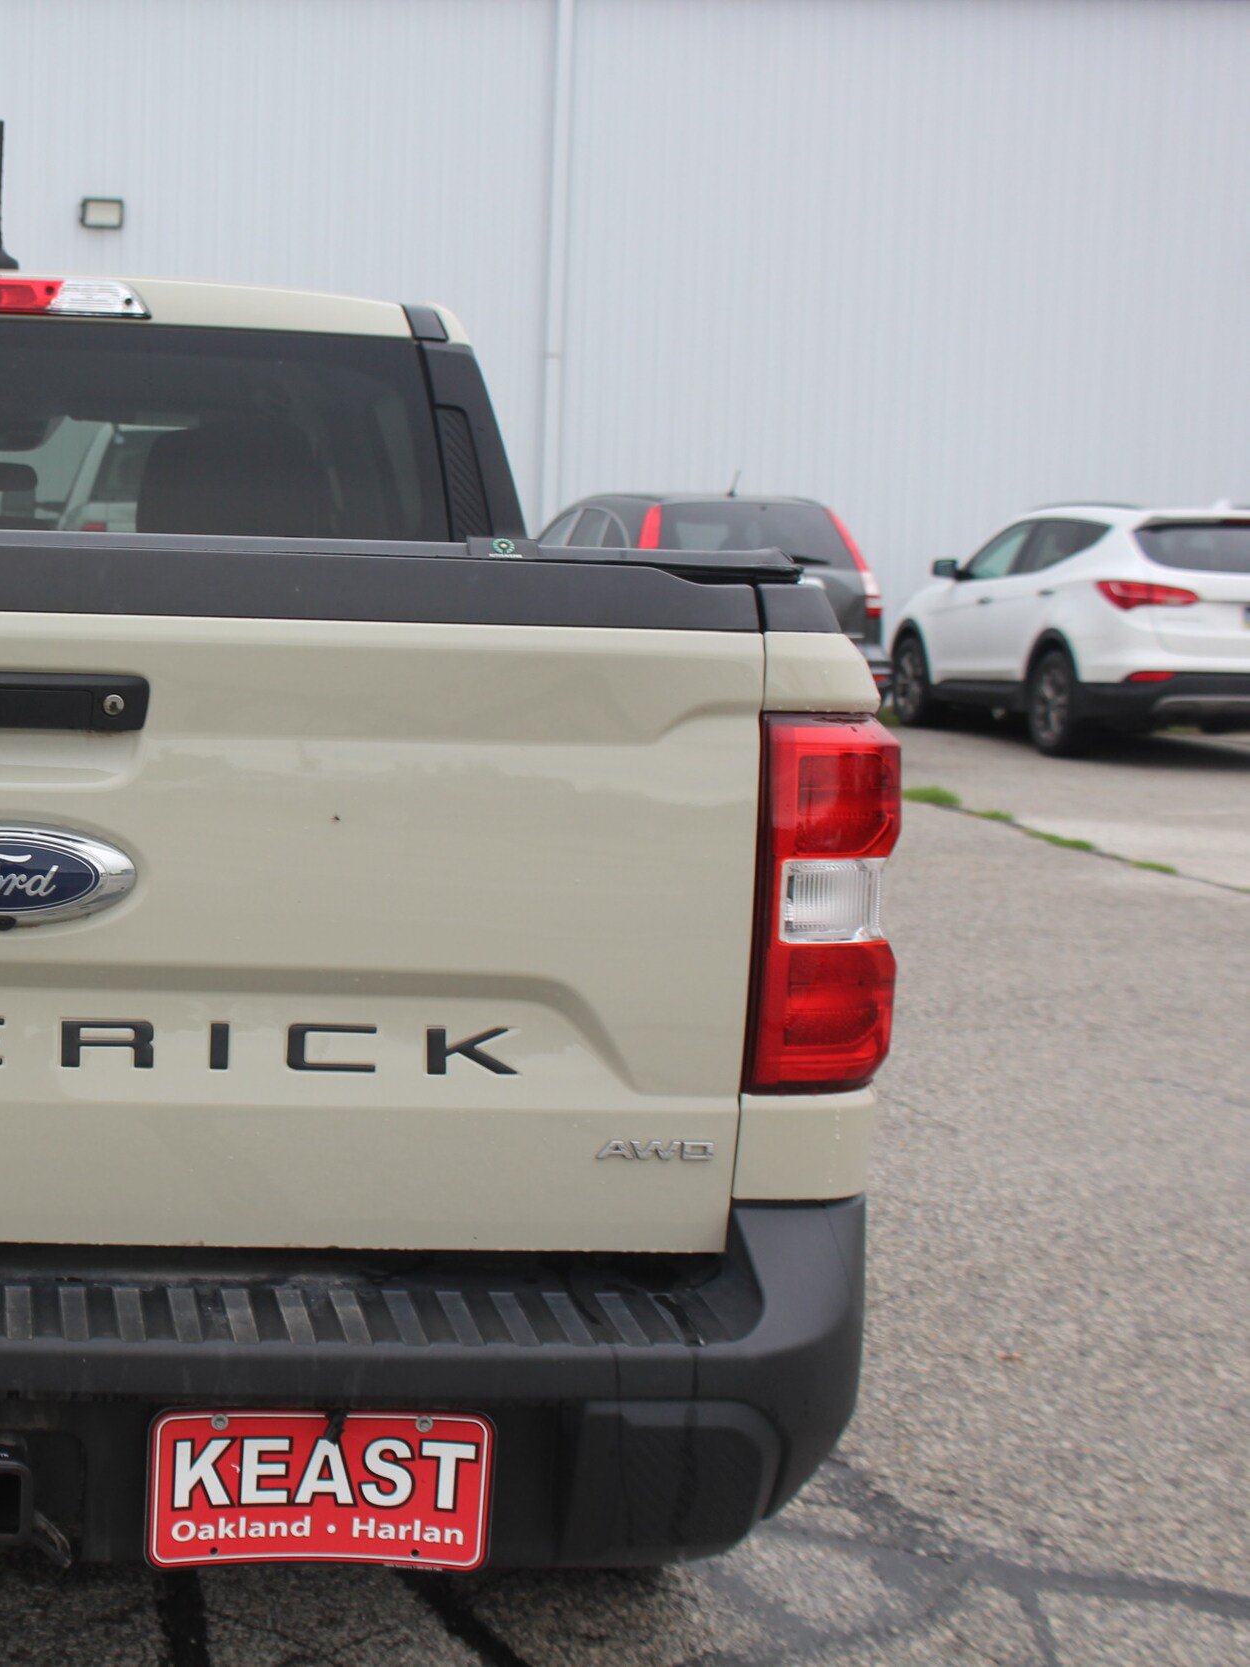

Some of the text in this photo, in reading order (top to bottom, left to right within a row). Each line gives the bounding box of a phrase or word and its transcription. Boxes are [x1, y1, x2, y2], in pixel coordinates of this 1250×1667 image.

[595, 1138, 715, 1161] AWD
[171, 1436, 480, 1512] KEAST
[170, 1516, 465, 1546] Oakland Harlan
